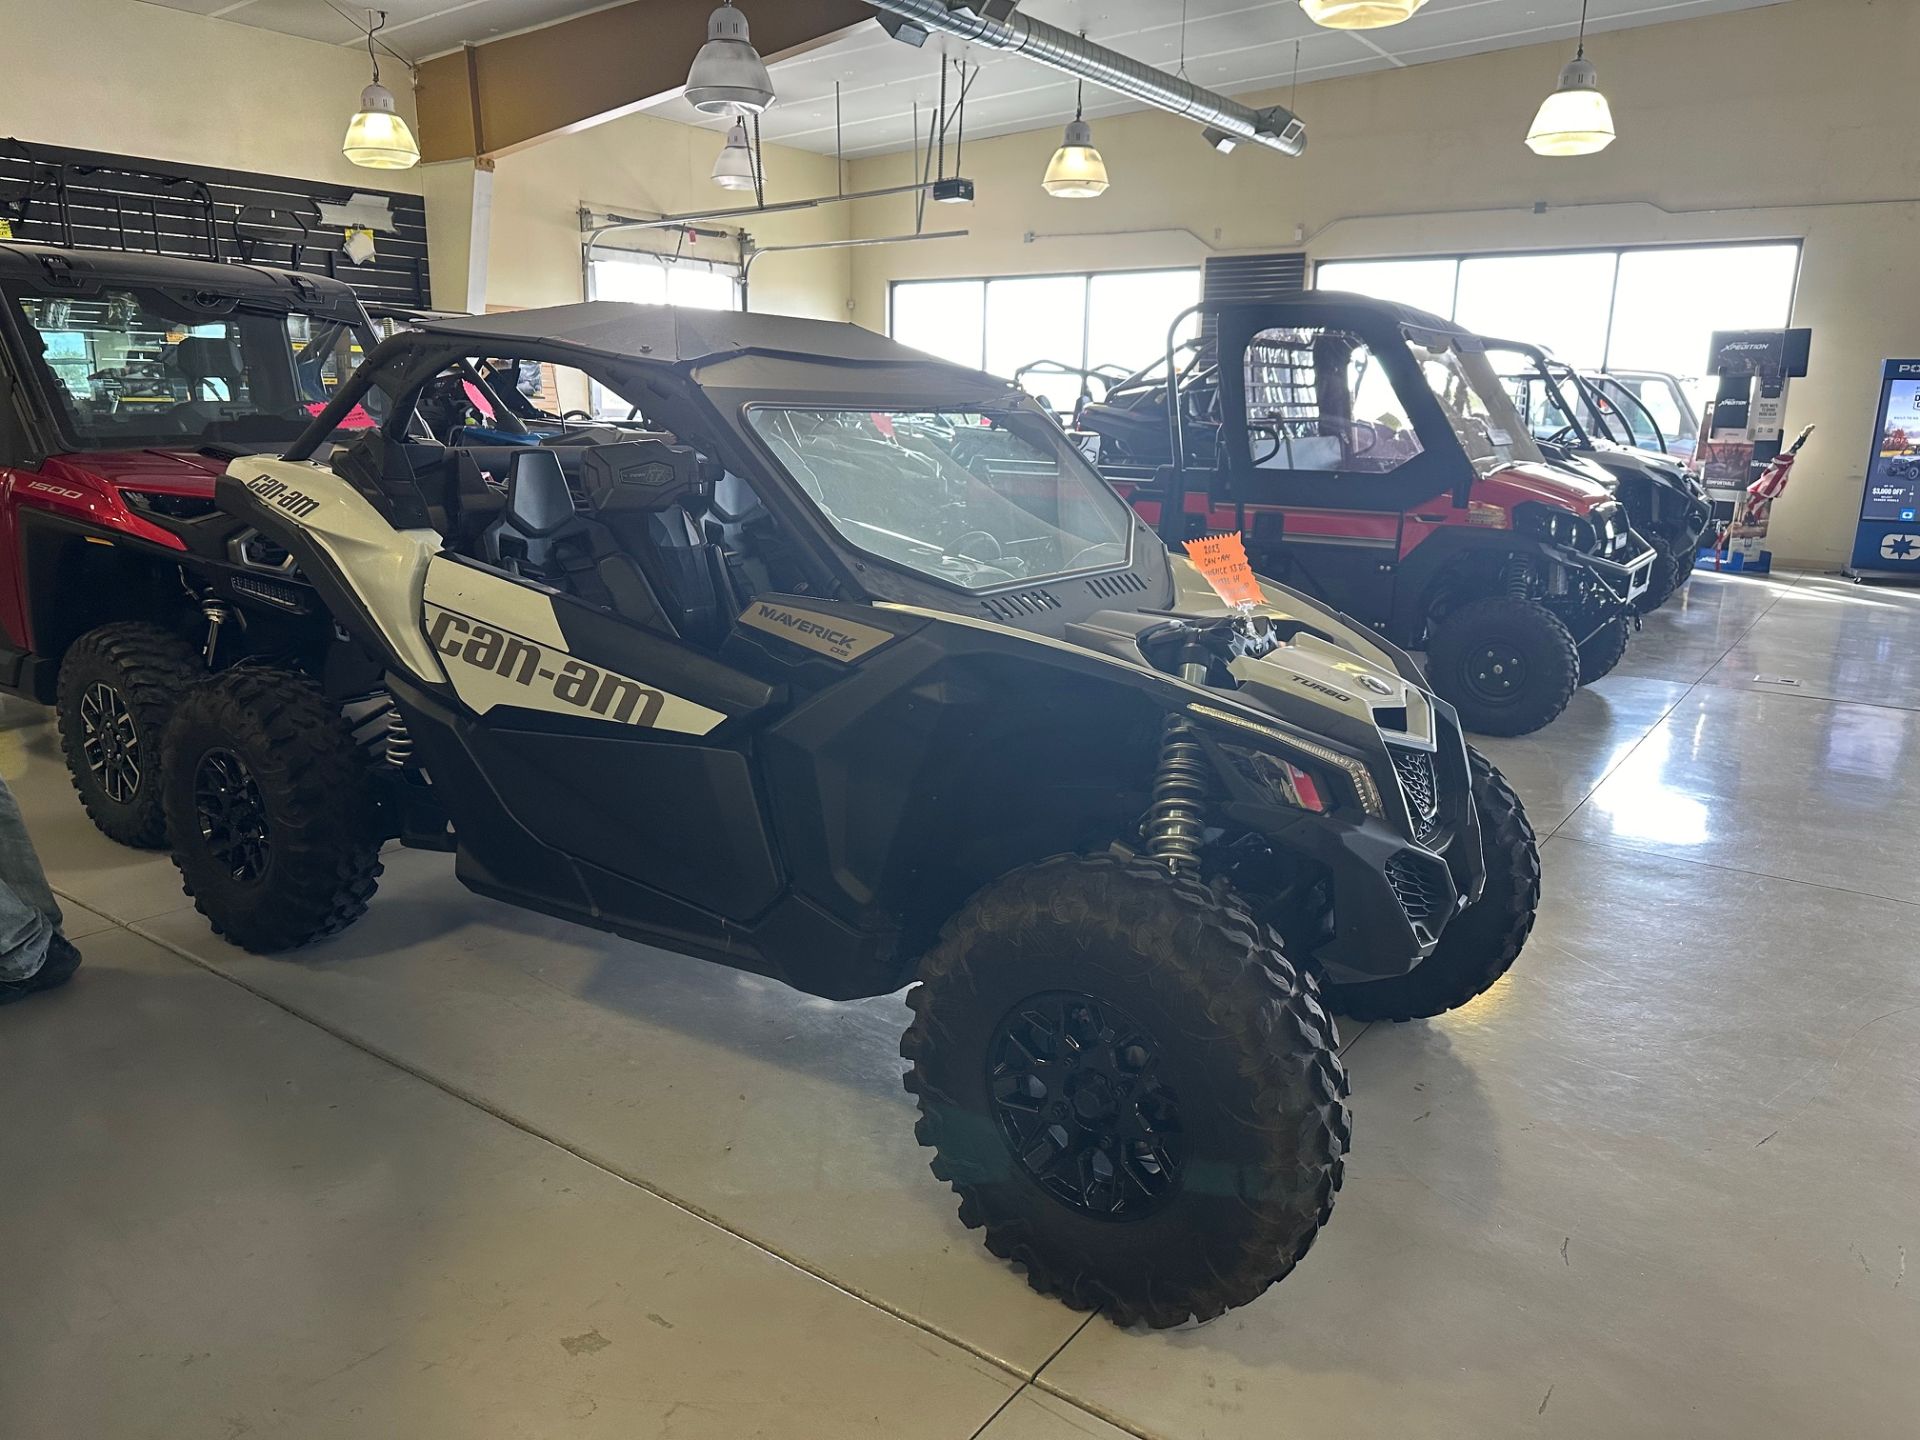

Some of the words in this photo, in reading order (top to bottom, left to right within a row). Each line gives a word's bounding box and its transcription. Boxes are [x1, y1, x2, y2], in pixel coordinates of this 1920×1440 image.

[1720, 342, 1769, 353] XPEDITION
[28, 481, 83, 499] 1500
[246, 473, 320, 518] can-am
[1872, 487, 1892, 495] $3,000
[758, 604, 857, 649] MAVERICK
[430, 611, 665, 728] can-am
[1291, 675, 1351, 702] TURBO
